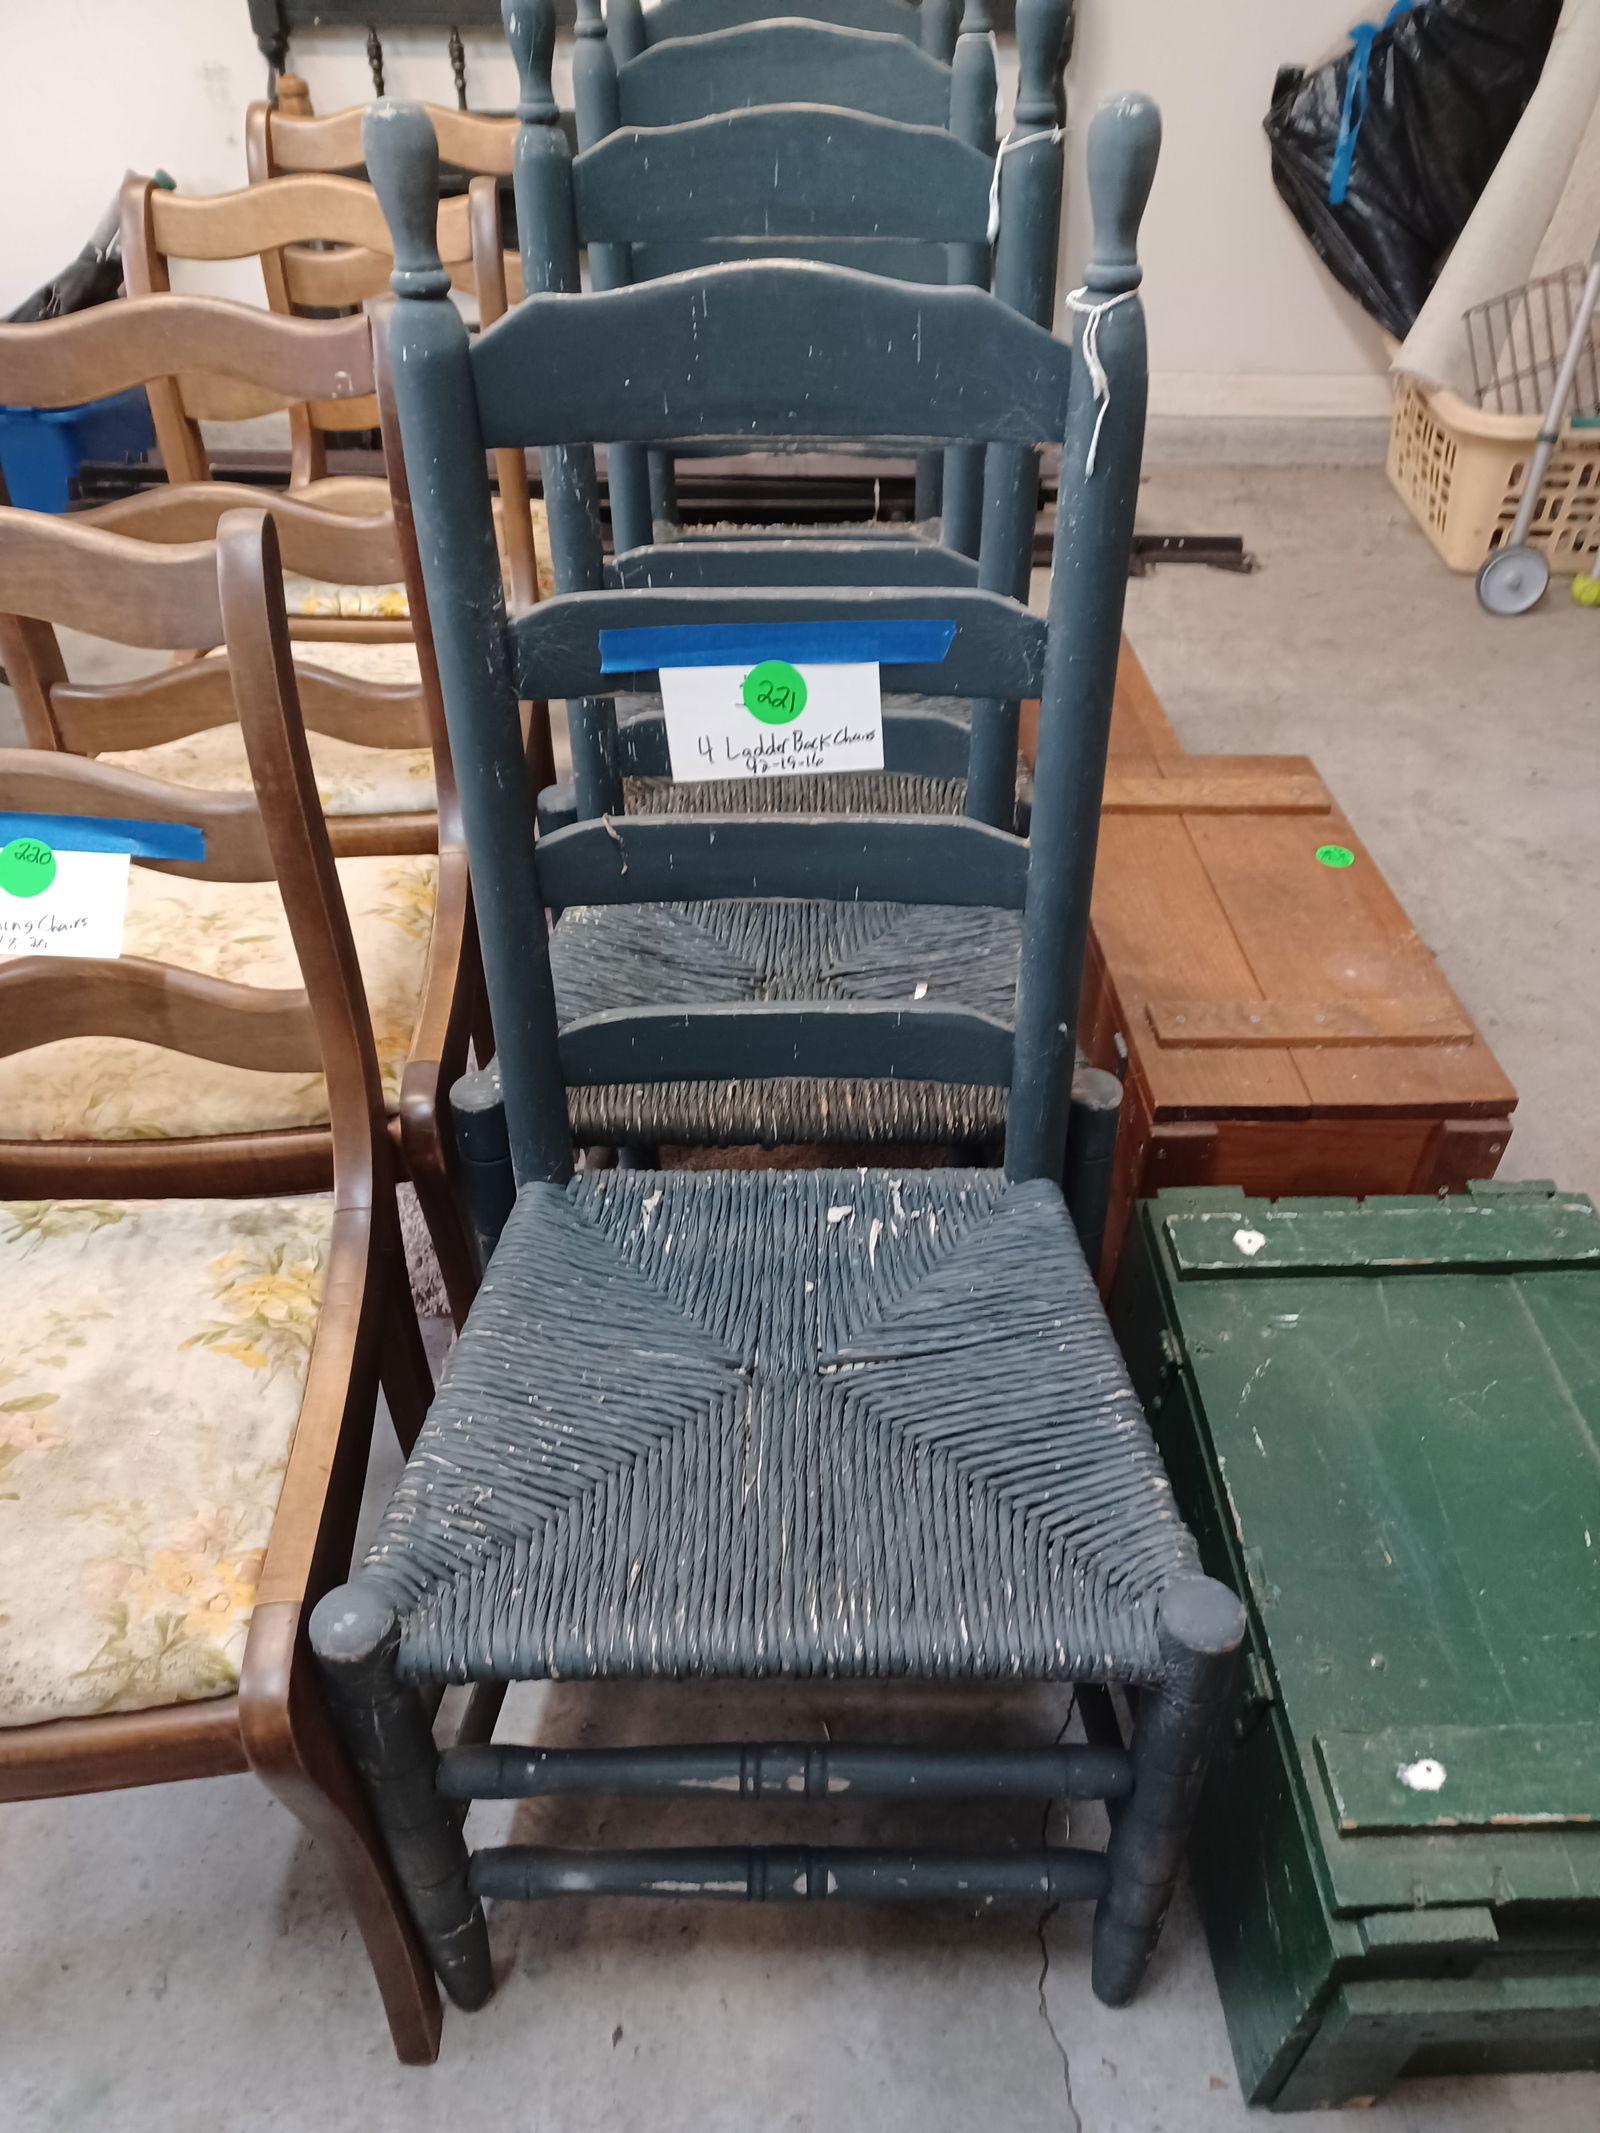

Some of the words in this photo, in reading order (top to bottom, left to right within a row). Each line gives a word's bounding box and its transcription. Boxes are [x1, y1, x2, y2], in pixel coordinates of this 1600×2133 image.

[757, 679, 796, 713] 221
[698, 735, 715, 764] 4
[725, 732, 790, 761] Ladder
[792, 729, 832, 752] Back
[14, 842, 52, 865] 220
[37, 913, 88, 933] Chairs
